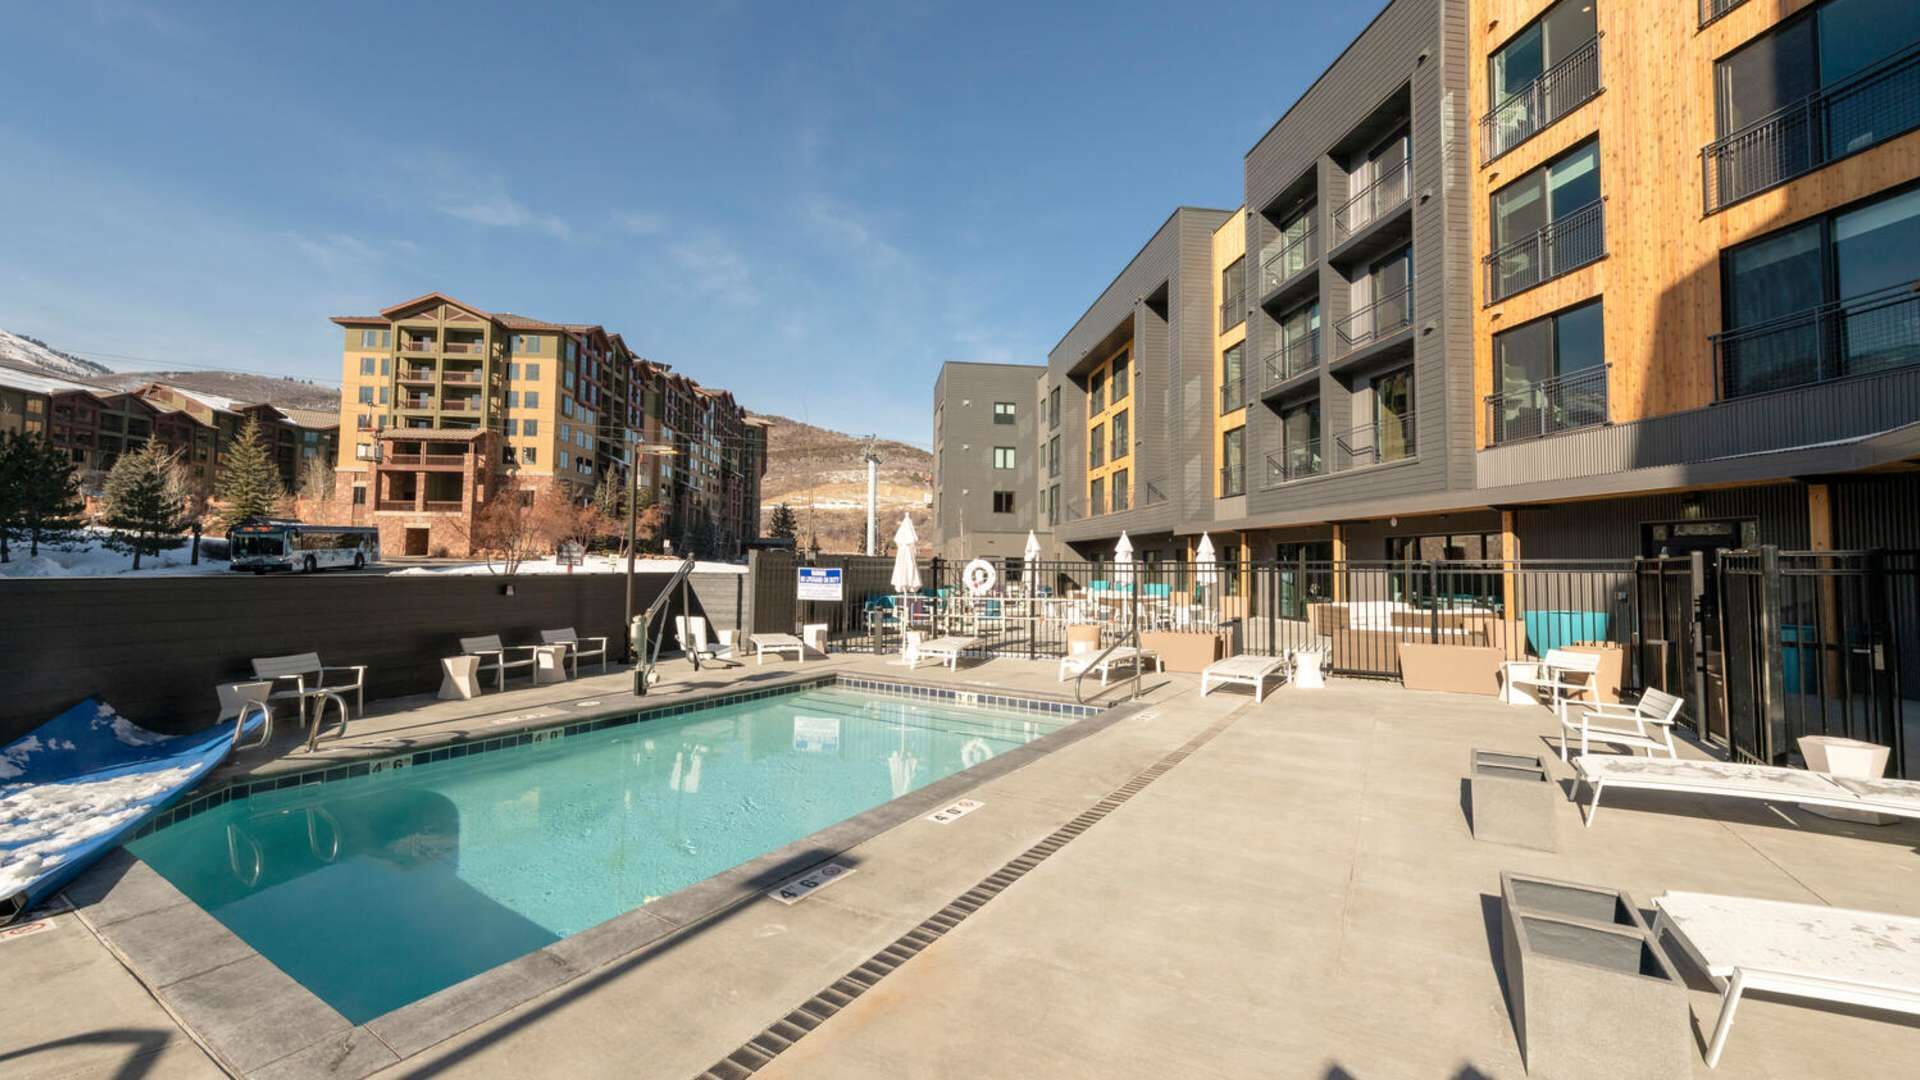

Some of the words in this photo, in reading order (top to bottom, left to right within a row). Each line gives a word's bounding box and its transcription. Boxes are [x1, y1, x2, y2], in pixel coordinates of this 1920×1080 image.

[371, 762, 382, 773] 4
[393, 759, 404, 769] 6
[780, 890, 797, 898] 4
[800, 880, 819, 888] 6
